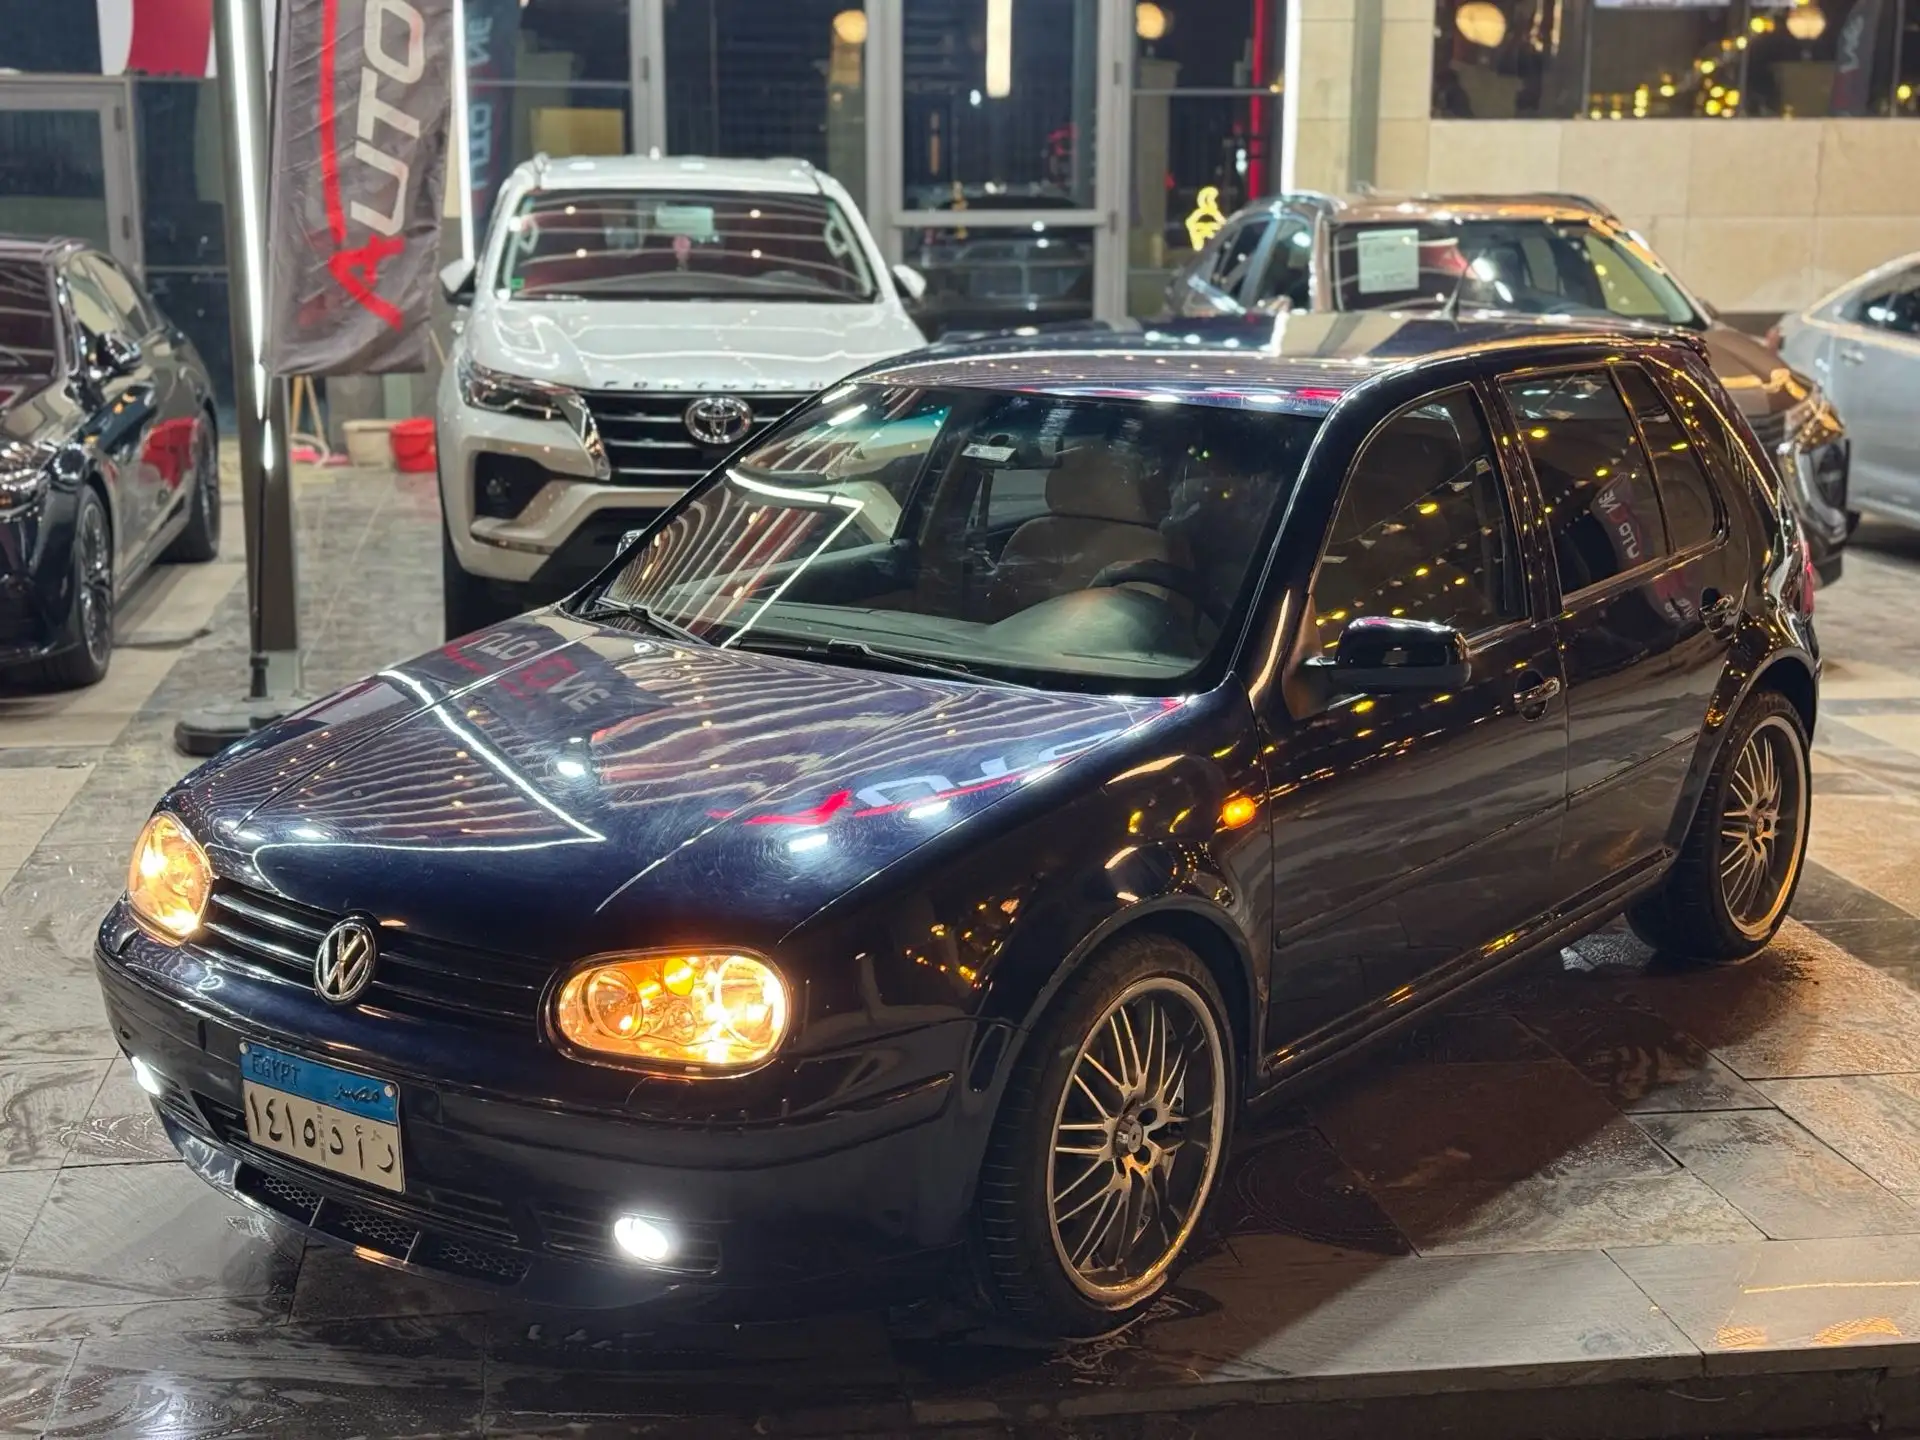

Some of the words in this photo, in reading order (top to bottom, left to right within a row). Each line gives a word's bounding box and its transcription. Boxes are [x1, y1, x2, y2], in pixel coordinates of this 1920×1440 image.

[251, 1051, 300, 1088] EGYPT
[334, 1082, 381, 1105] مصر
[249, 1092, 316, 1148] ١٤١٥
